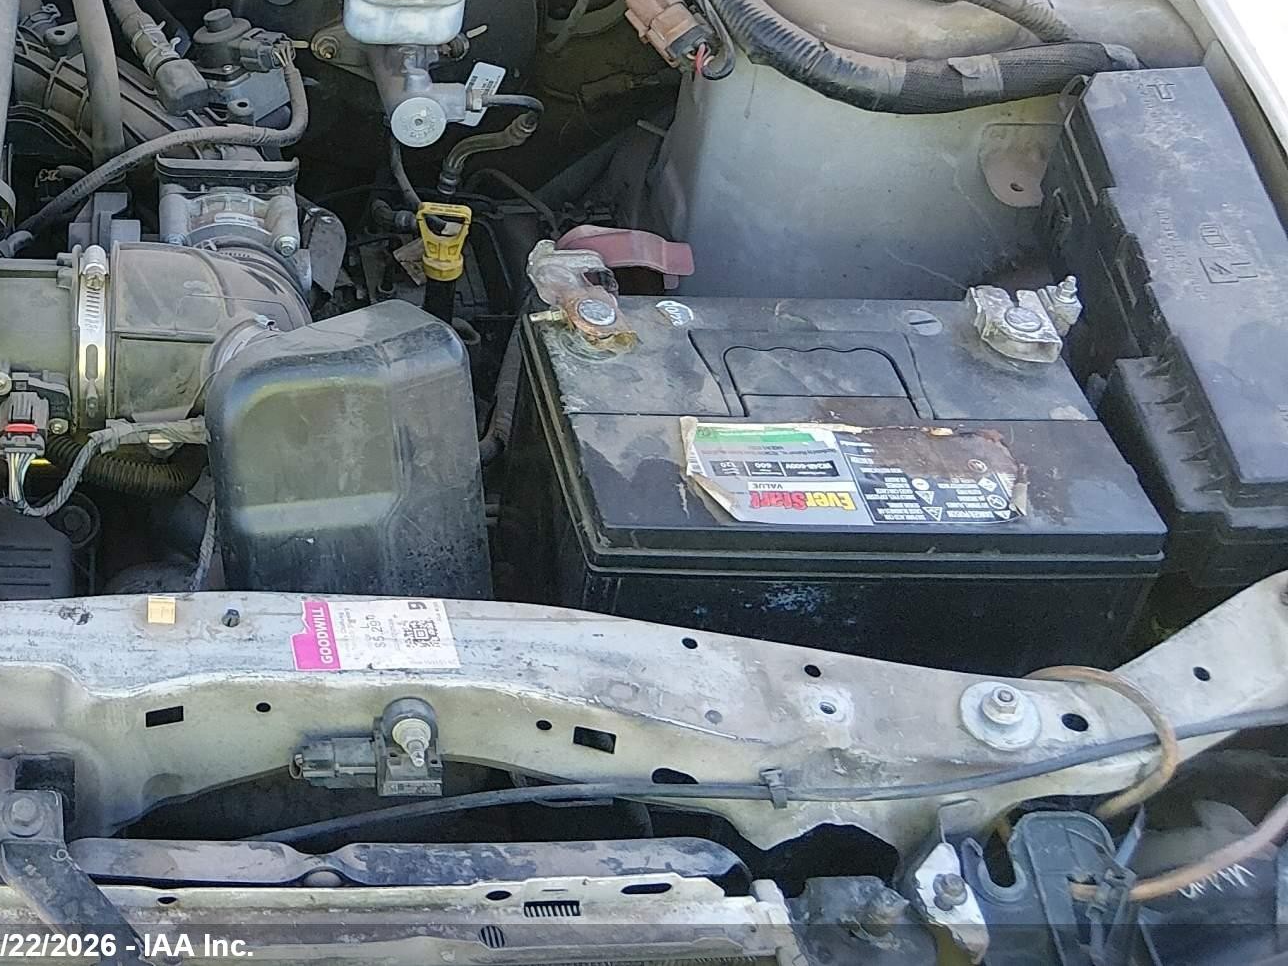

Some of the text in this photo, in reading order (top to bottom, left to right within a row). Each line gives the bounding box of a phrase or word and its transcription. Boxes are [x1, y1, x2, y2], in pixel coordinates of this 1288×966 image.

[752, 481, 784, 490] VALUE
[750, 491, 857, 510] EverStart
[312, 607, 333, 664] GOODWILL
